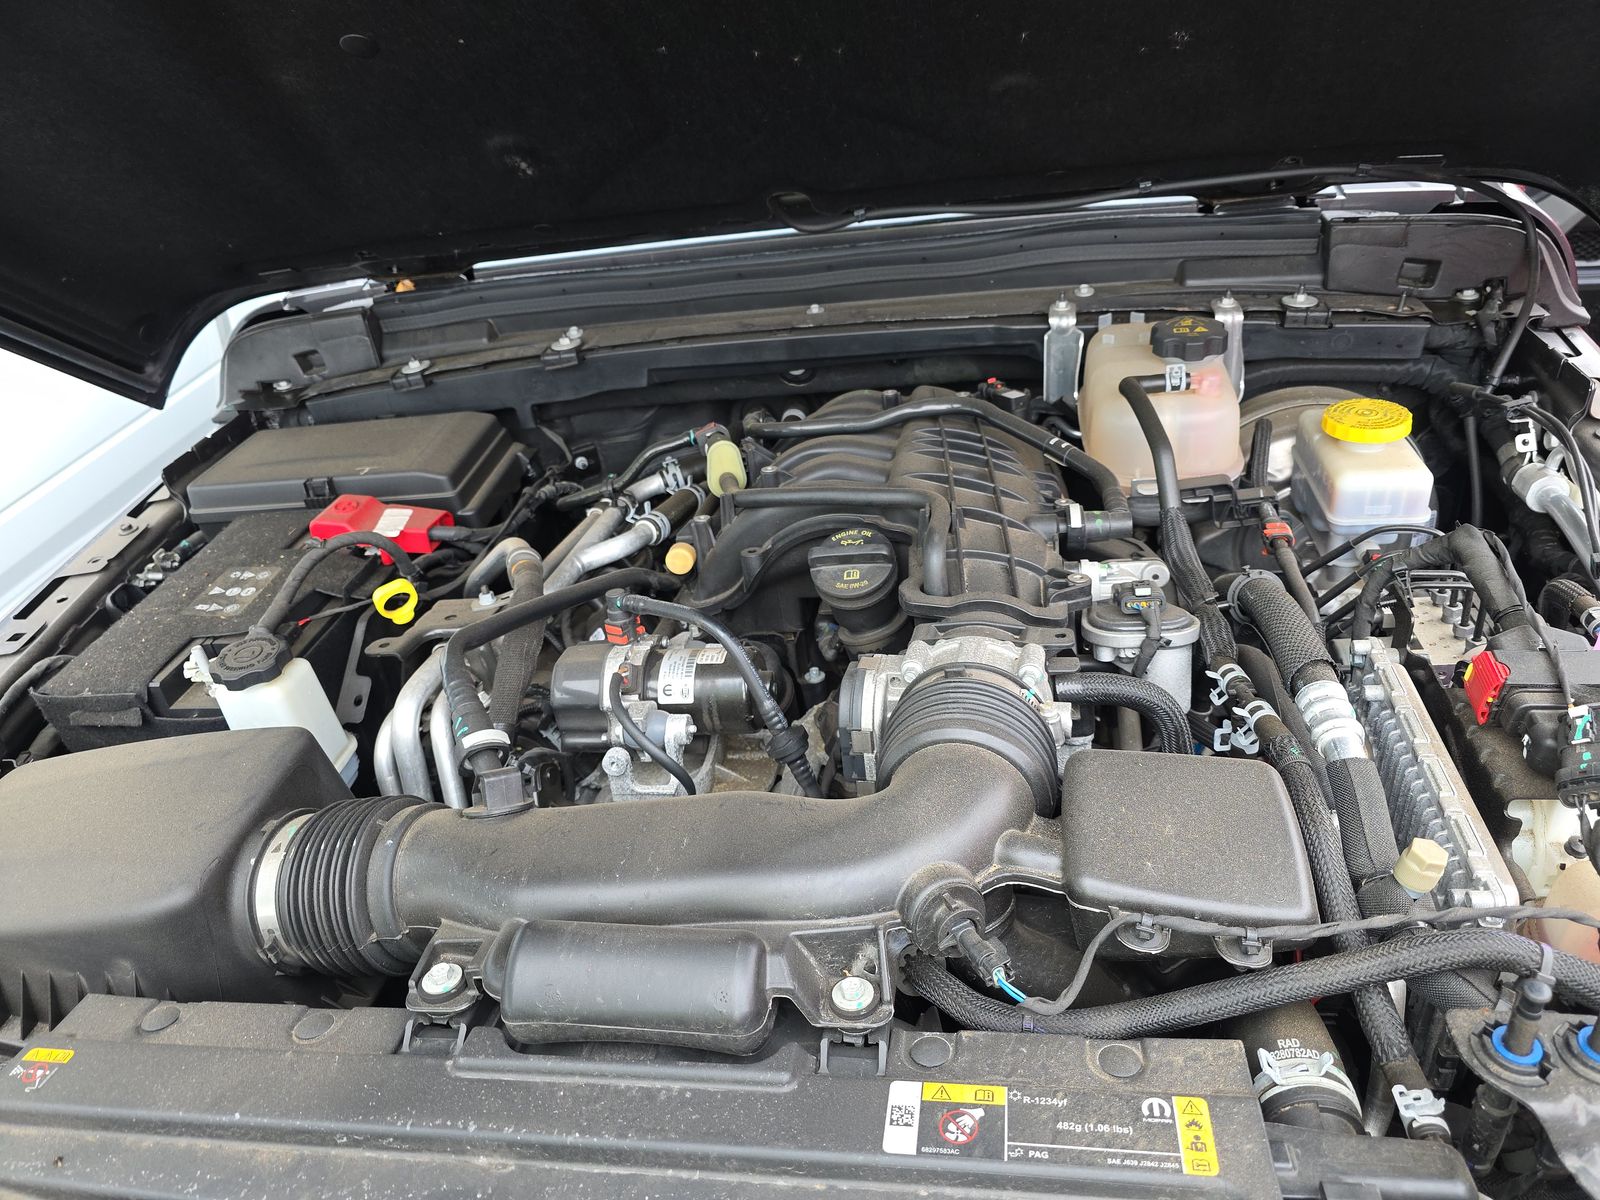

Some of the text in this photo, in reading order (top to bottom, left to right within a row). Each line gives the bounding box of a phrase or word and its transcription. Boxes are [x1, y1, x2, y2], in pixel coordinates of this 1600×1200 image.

[831, 529, 859, 541] ENGINE
[1277, 1038, 1300, 1048] RAD
[1023, 1095, 1068, 1108] R-1234yf
[1056, 1121, 1134, 1136] 482g (1.06 lbs)
[1028, 1149, 1049, 1159] PAG
[1107, 1157, 1122, 1165] SAE
